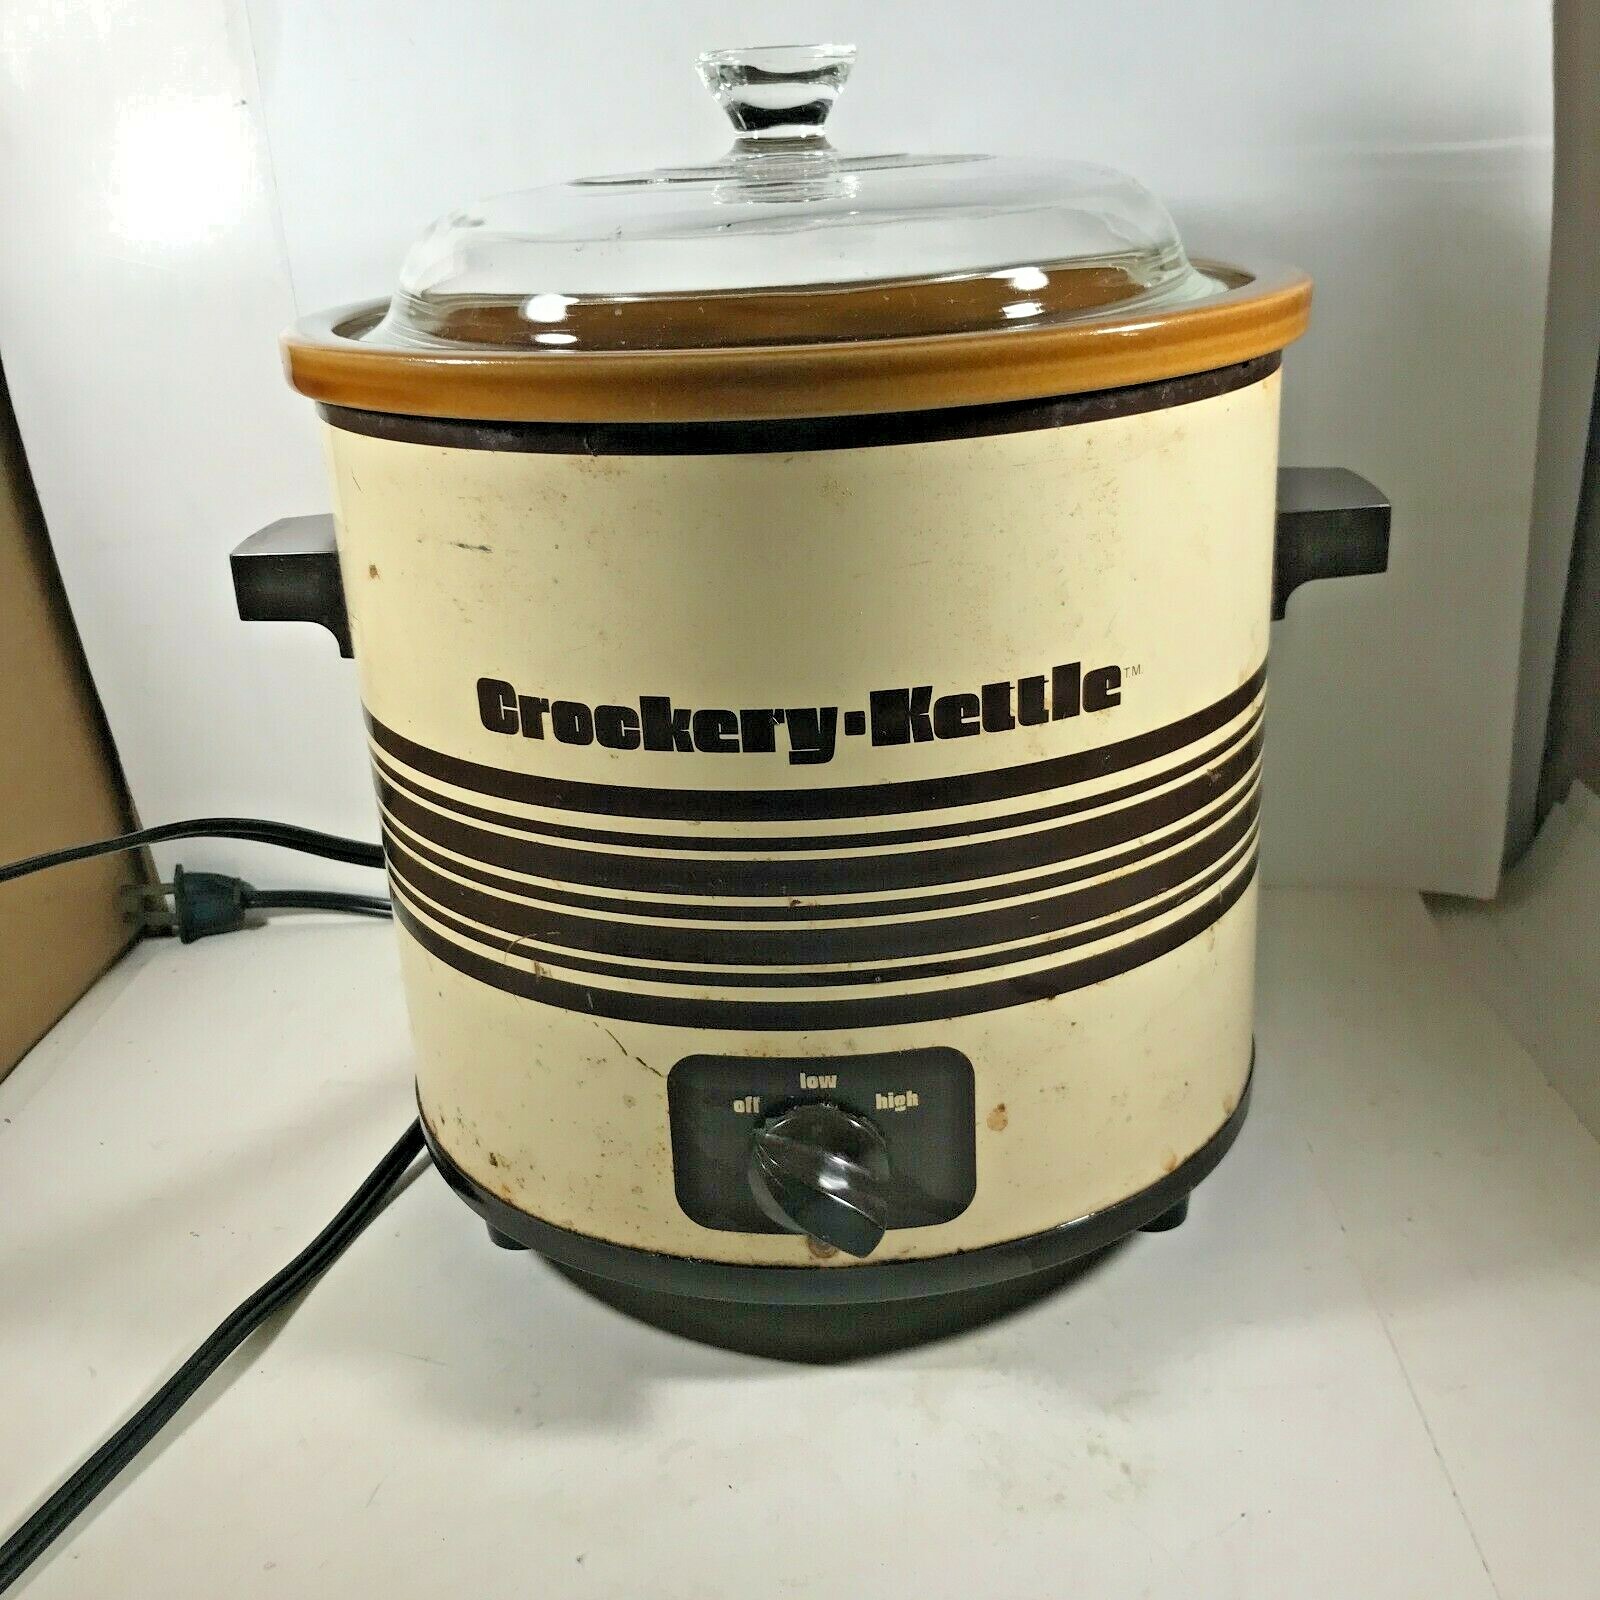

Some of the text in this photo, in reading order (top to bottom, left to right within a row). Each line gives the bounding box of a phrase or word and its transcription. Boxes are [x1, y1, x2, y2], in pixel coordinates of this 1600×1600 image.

[799, 1072, 838, 1090] low
[733, 1095, 761, 1114] off
[875, 1090, 919, 1112] high
